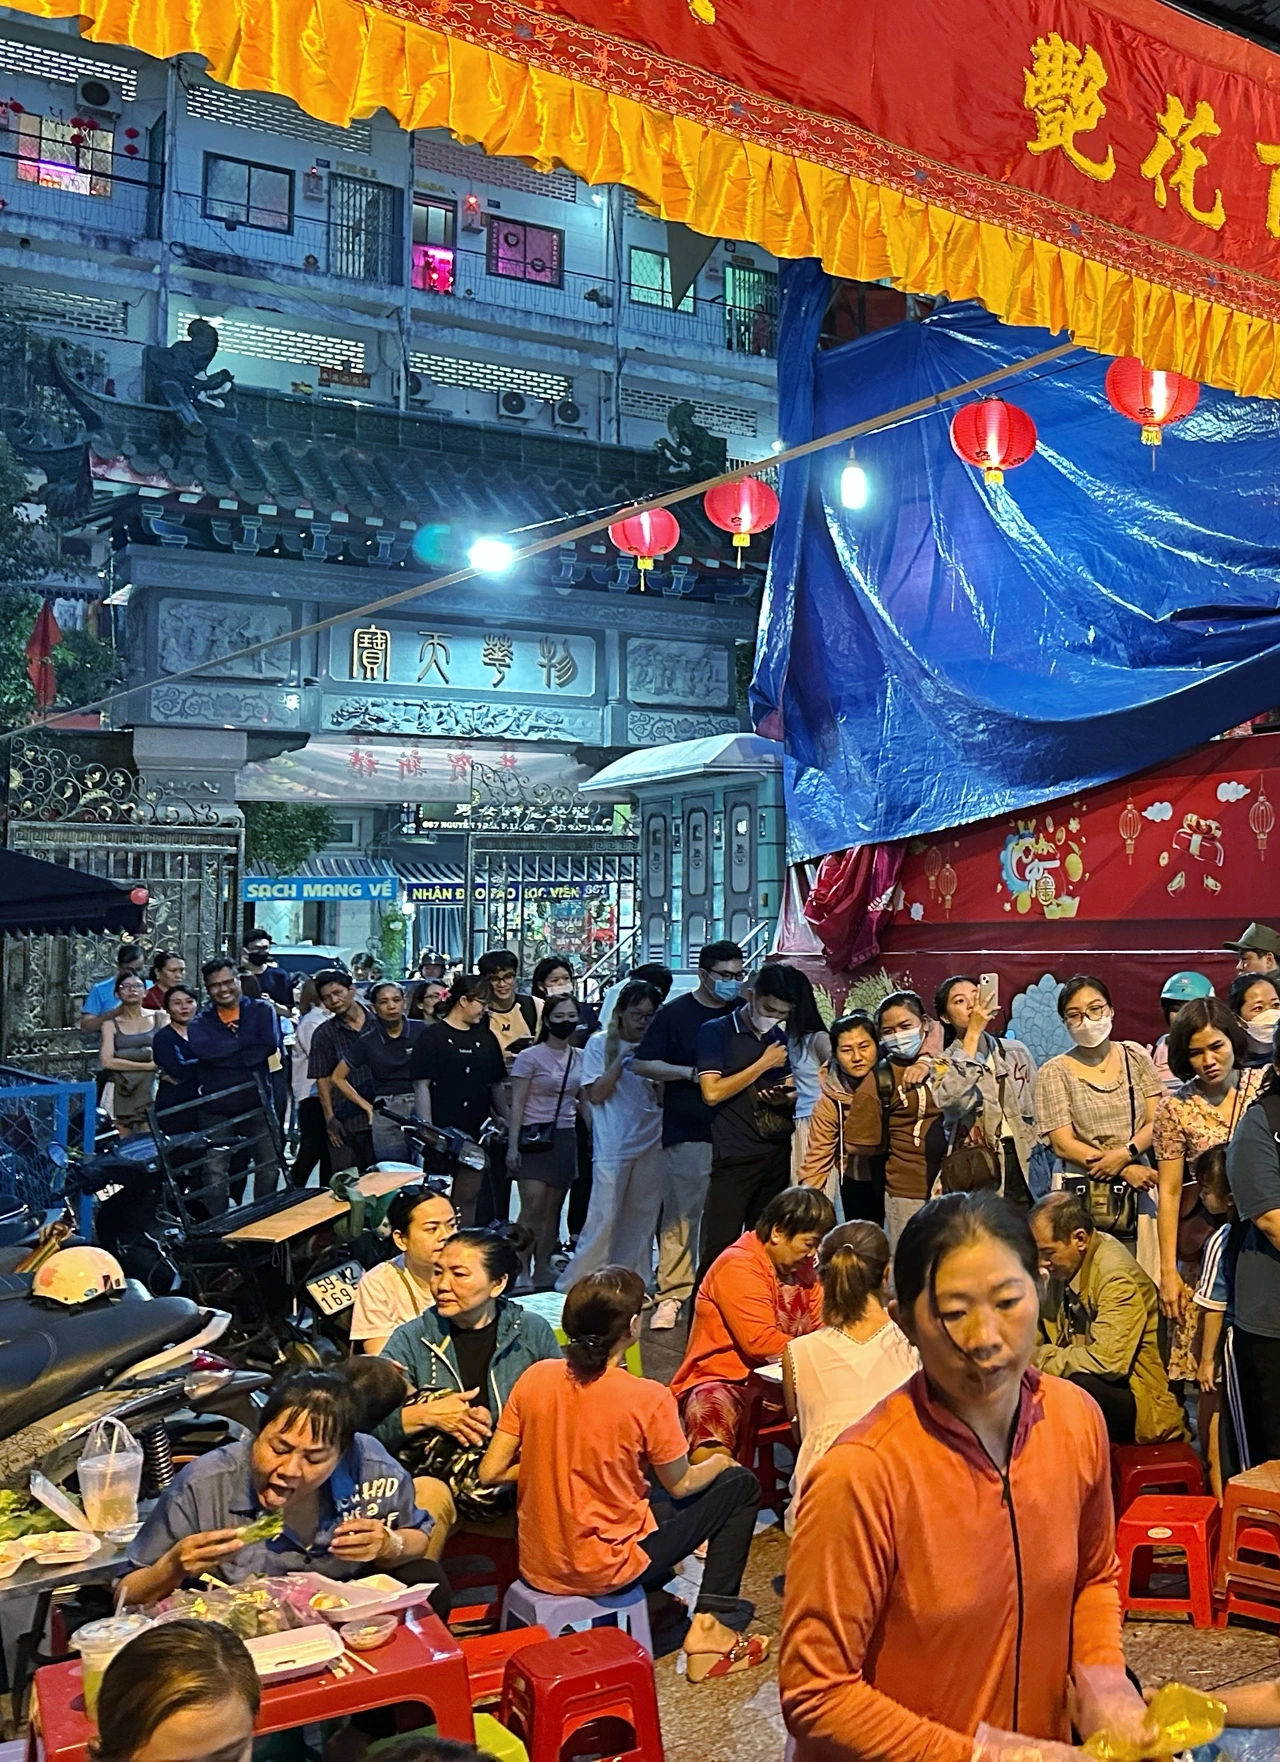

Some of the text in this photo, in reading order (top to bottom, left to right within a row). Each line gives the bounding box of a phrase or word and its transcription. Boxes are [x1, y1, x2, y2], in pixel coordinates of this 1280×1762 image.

[303, 884, 362, 897] MANG
[368, 879, 392, 897] VỀ
[413, 885, 452, 903] NHẬN
[455, 888, 486, 899] ĐO
